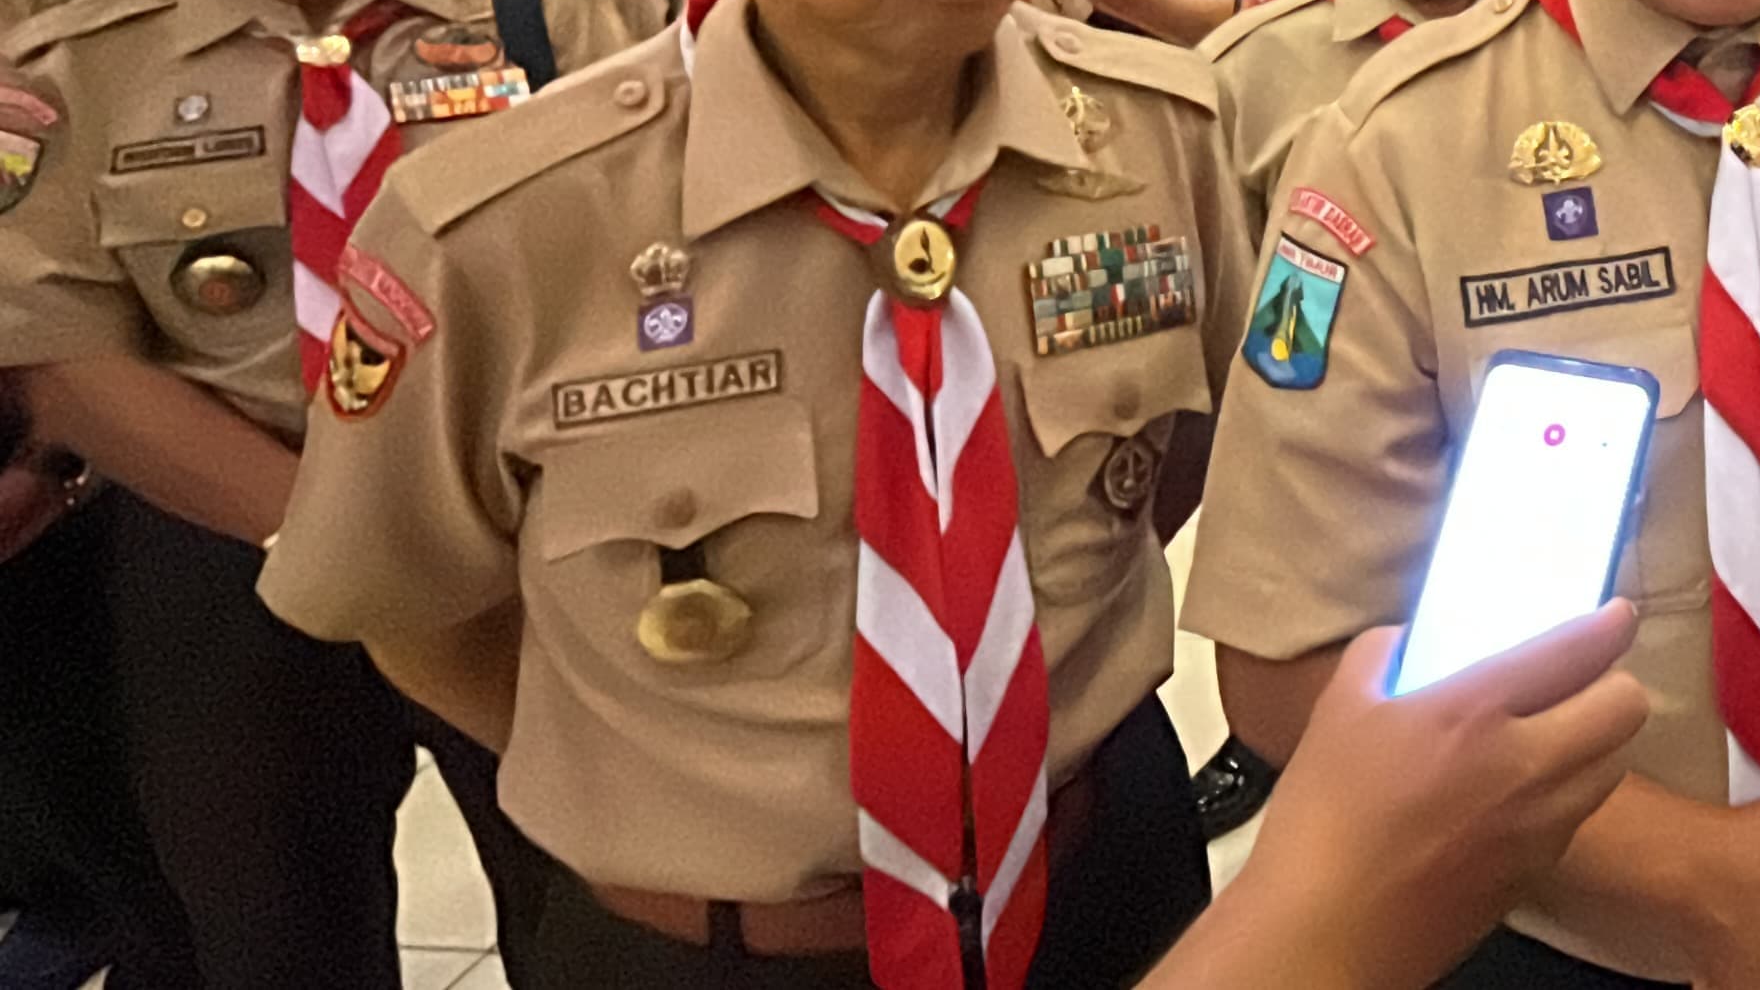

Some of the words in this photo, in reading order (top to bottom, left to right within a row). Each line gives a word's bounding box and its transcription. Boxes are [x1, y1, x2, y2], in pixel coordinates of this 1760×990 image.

[1527, 268, 1589, 308] ARUM
[1598, 260, 1661, 294] SABIL
[563, 359, 772, 418] BACHTIAR
